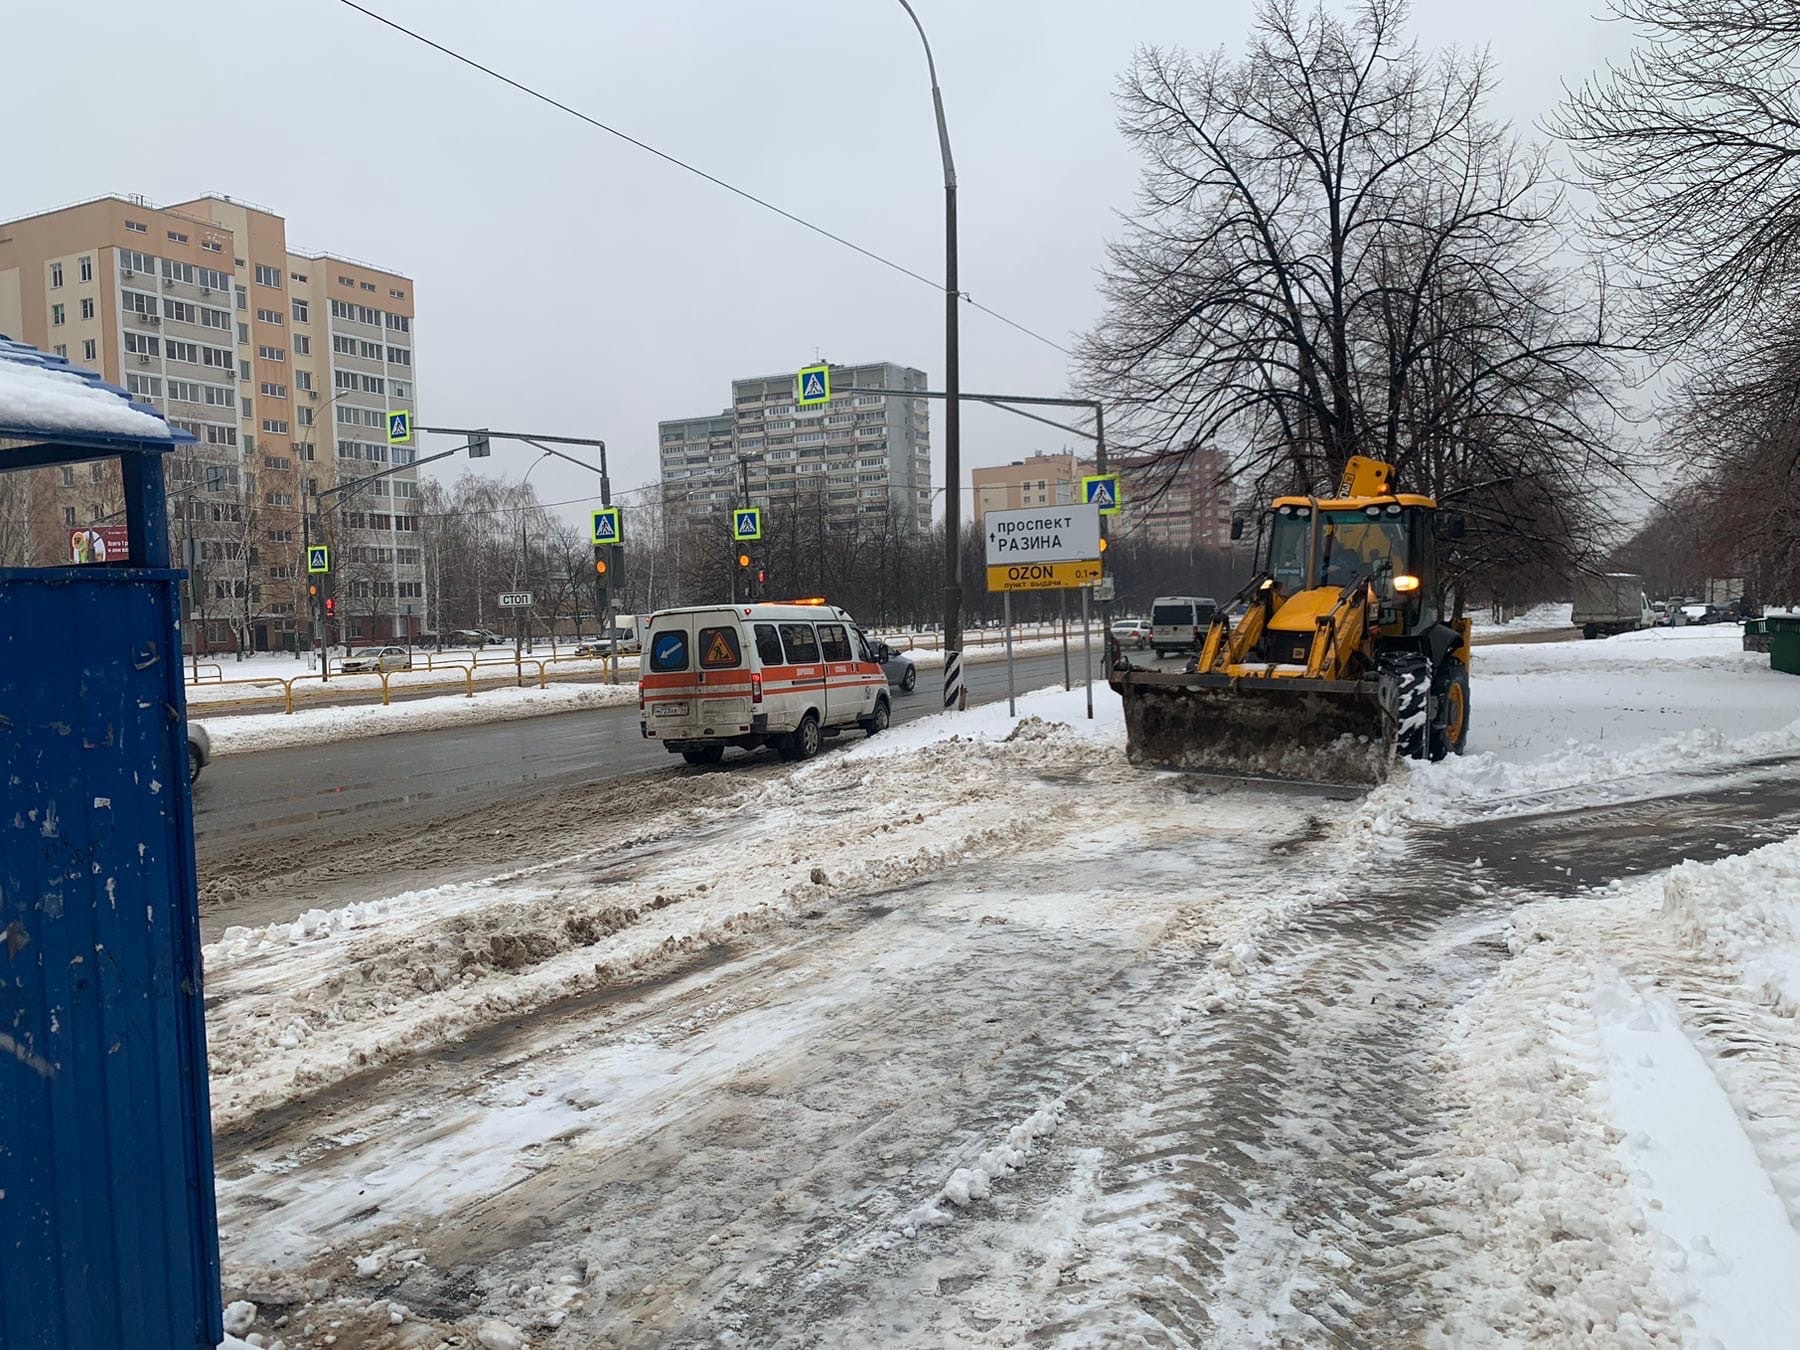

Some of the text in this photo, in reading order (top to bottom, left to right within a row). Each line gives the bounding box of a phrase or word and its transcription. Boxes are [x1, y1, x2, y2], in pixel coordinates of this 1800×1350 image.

[998, 518, 1072, 535] проспект
[999, 535, 1062, 551] РАЗИНА
[1008, 566, 1053, 580] OZON
[503, 595, 528, 605] СТОП
